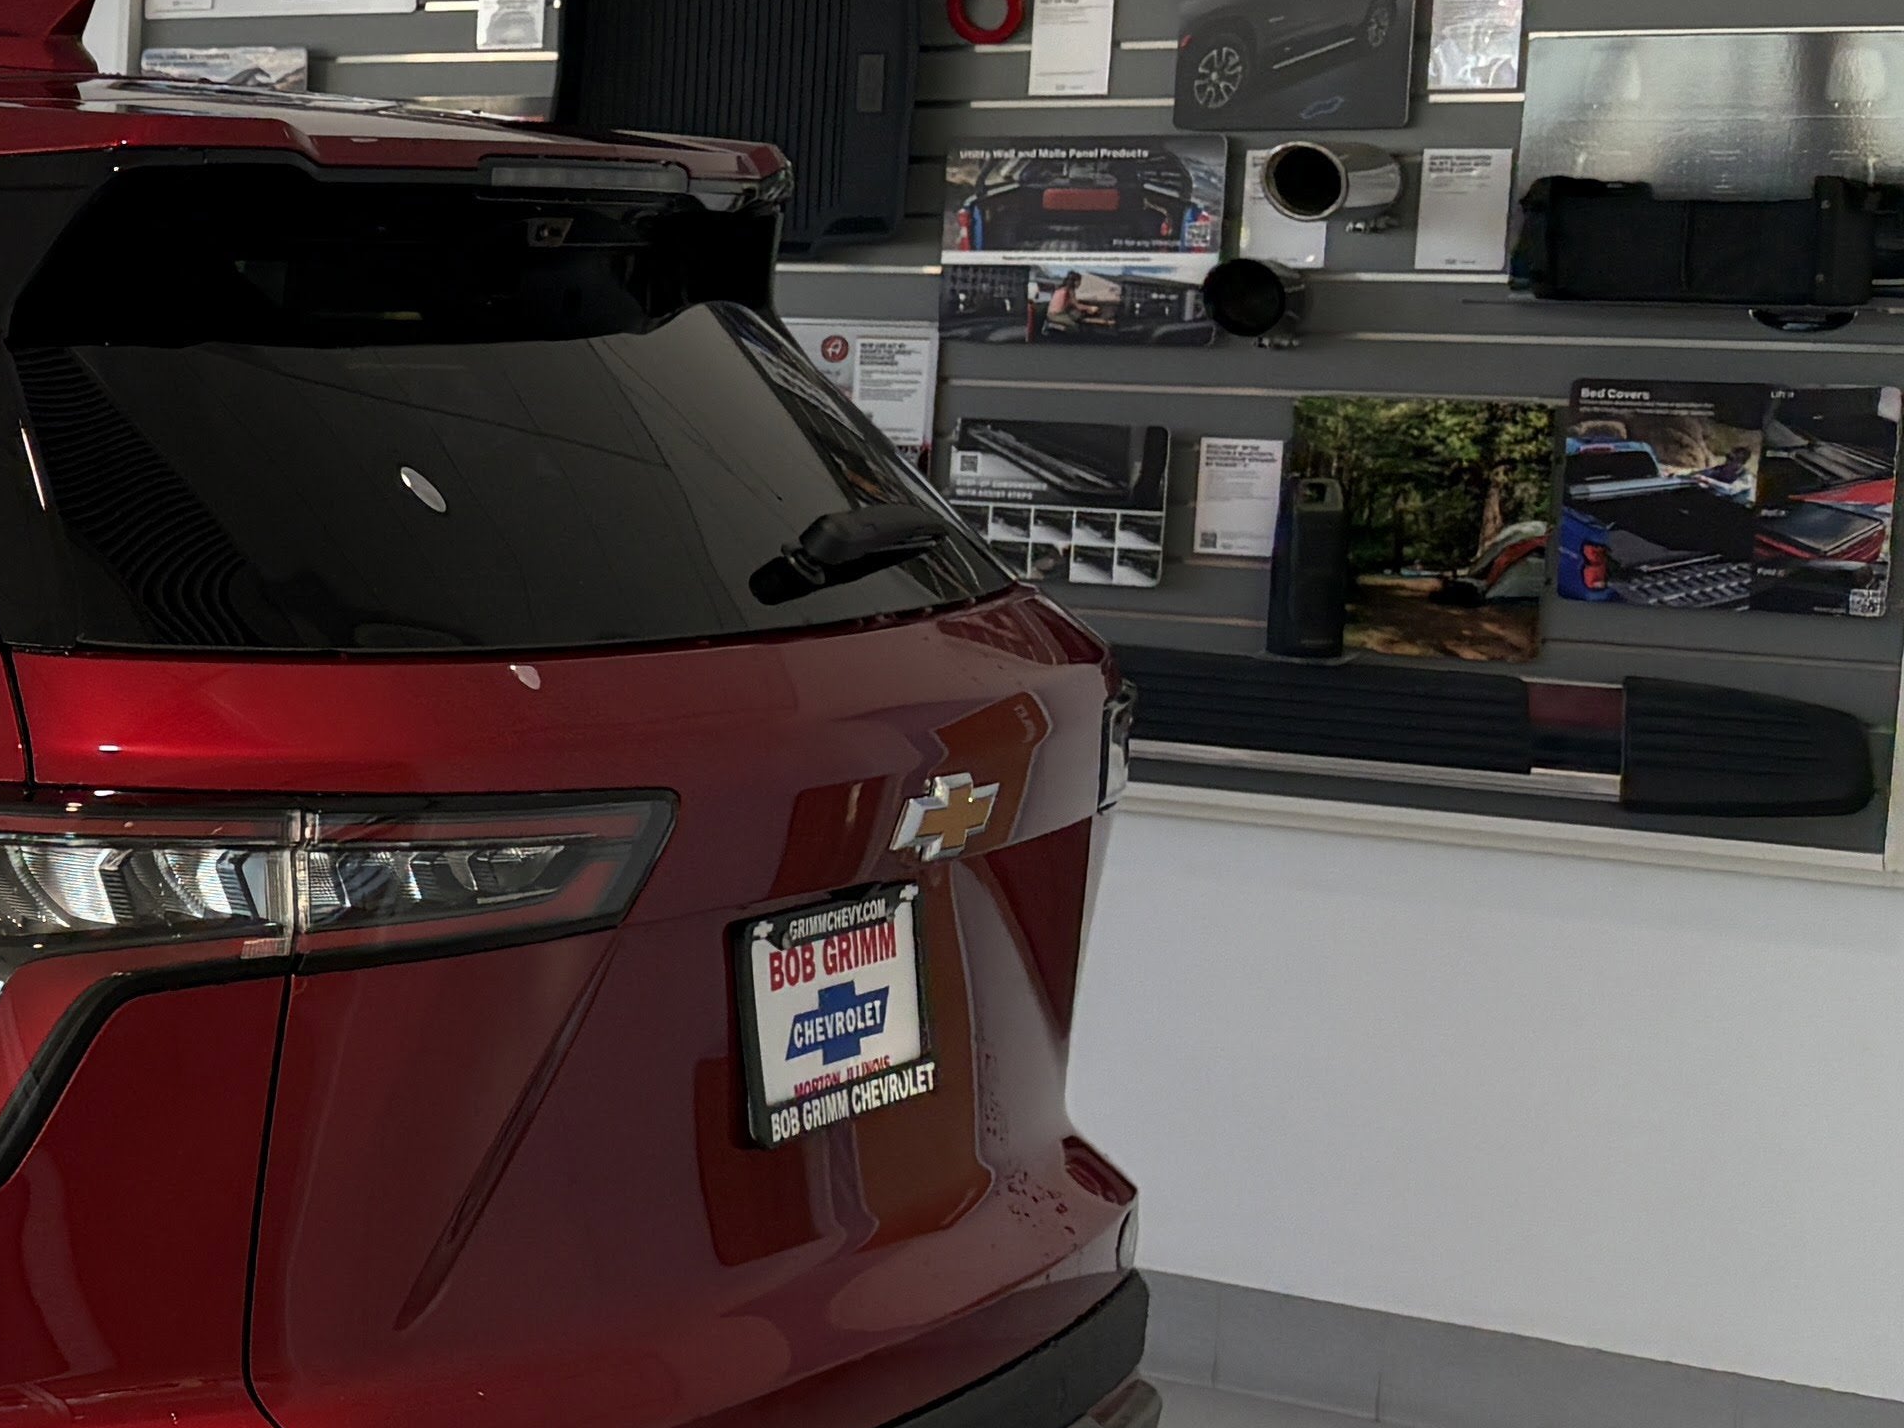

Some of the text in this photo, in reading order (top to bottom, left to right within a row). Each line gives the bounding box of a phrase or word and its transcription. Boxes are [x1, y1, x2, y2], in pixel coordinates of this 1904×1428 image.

[993, 149, 1015, 159] Wall
[1017, 149, 1037, 159] and
[1068, 149, 1098, 159] Panel
[1100, 149, 1149, 159] Products
[1580, 387, 1650, 400] Bed Covers
[789, 897, 886, 941] GRIMMCHEVY.COM
[769, 921, 897, 992] BOB GRIMM
[793, 999, 882, 1049] CHEVROLET
[771, 1062, 936, 1143] BOB GRIMM CHEVROLET
